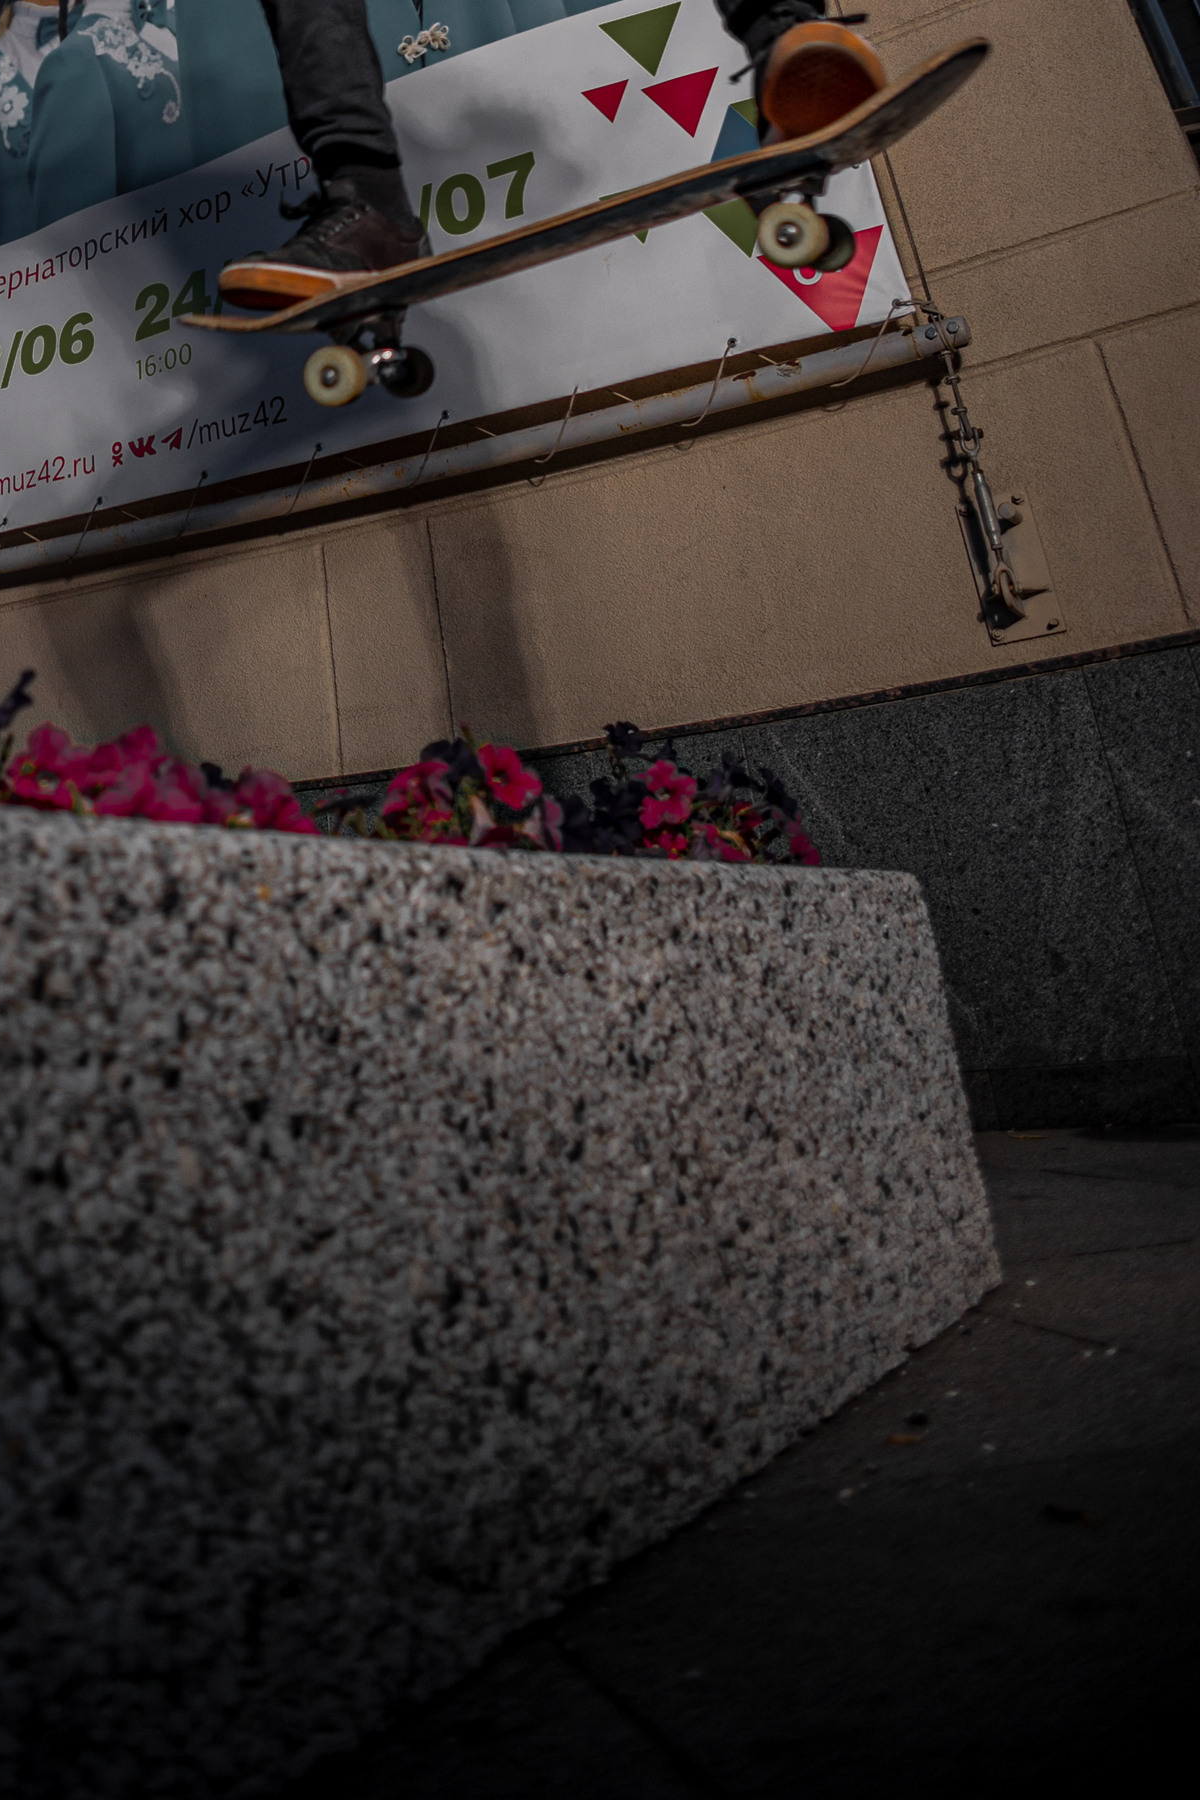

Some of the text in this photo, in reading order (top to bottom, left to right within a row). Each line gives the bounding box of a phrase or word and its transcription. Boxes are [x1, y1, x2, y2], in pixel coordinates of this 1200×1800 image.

[179, 189, 231, 227] хор
[135, 343, 192, 380] 16:00
[187, 396, 287, 449] /muz42
